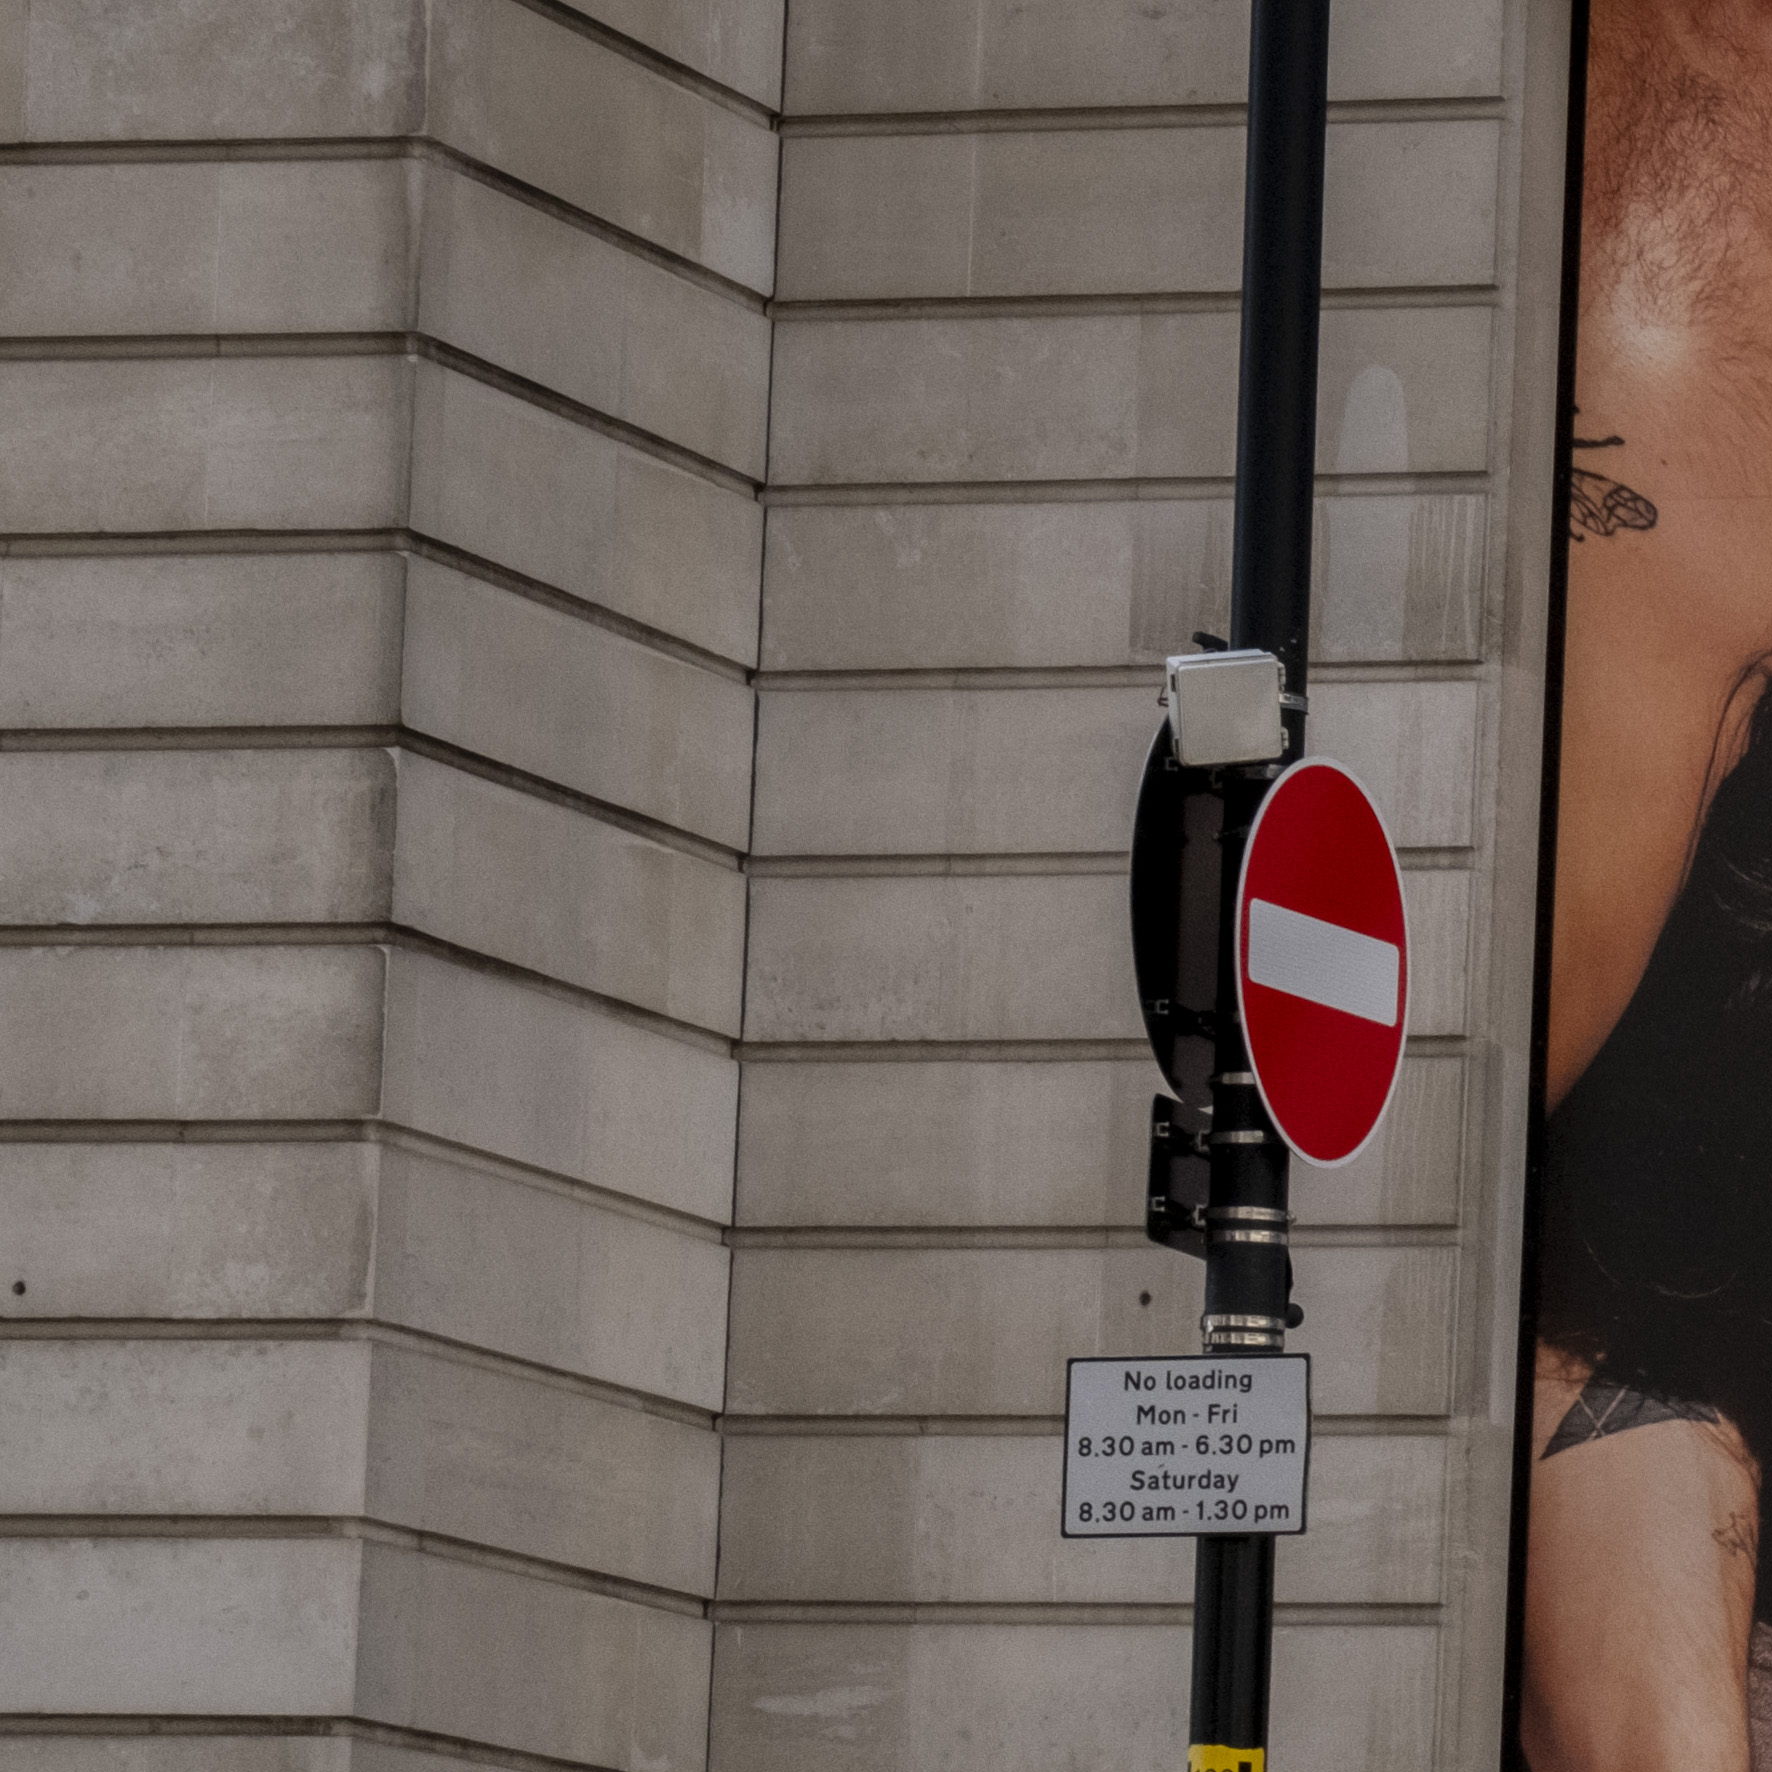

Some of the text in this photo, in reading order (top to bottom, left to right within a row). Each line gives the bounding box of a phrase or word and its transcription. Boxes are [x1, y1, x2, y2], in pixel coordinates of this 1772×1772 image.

[1123, 1369, 1253, 1394] No loading
[1136, 1404, 1186, 1426] Mon
[1207, 1403, 1239, 1424] Fri
[1077, 1435, 1135, 1458] 8.30
[1140, 1440, 1175, 1457] am
[1195, 1433, 1253, 1456] 6.30
[1258, 1438, 1296, 1459] pm
[1129, 1469, 1240, 1494] Saturday
[1078, 1500, 1136, 1523] 8.30
[1141, 1505, 1176, 1522] am
[1196, 1499, 1248, 1521] 1.30
[1253, 1504, 1290, 1524] pm
